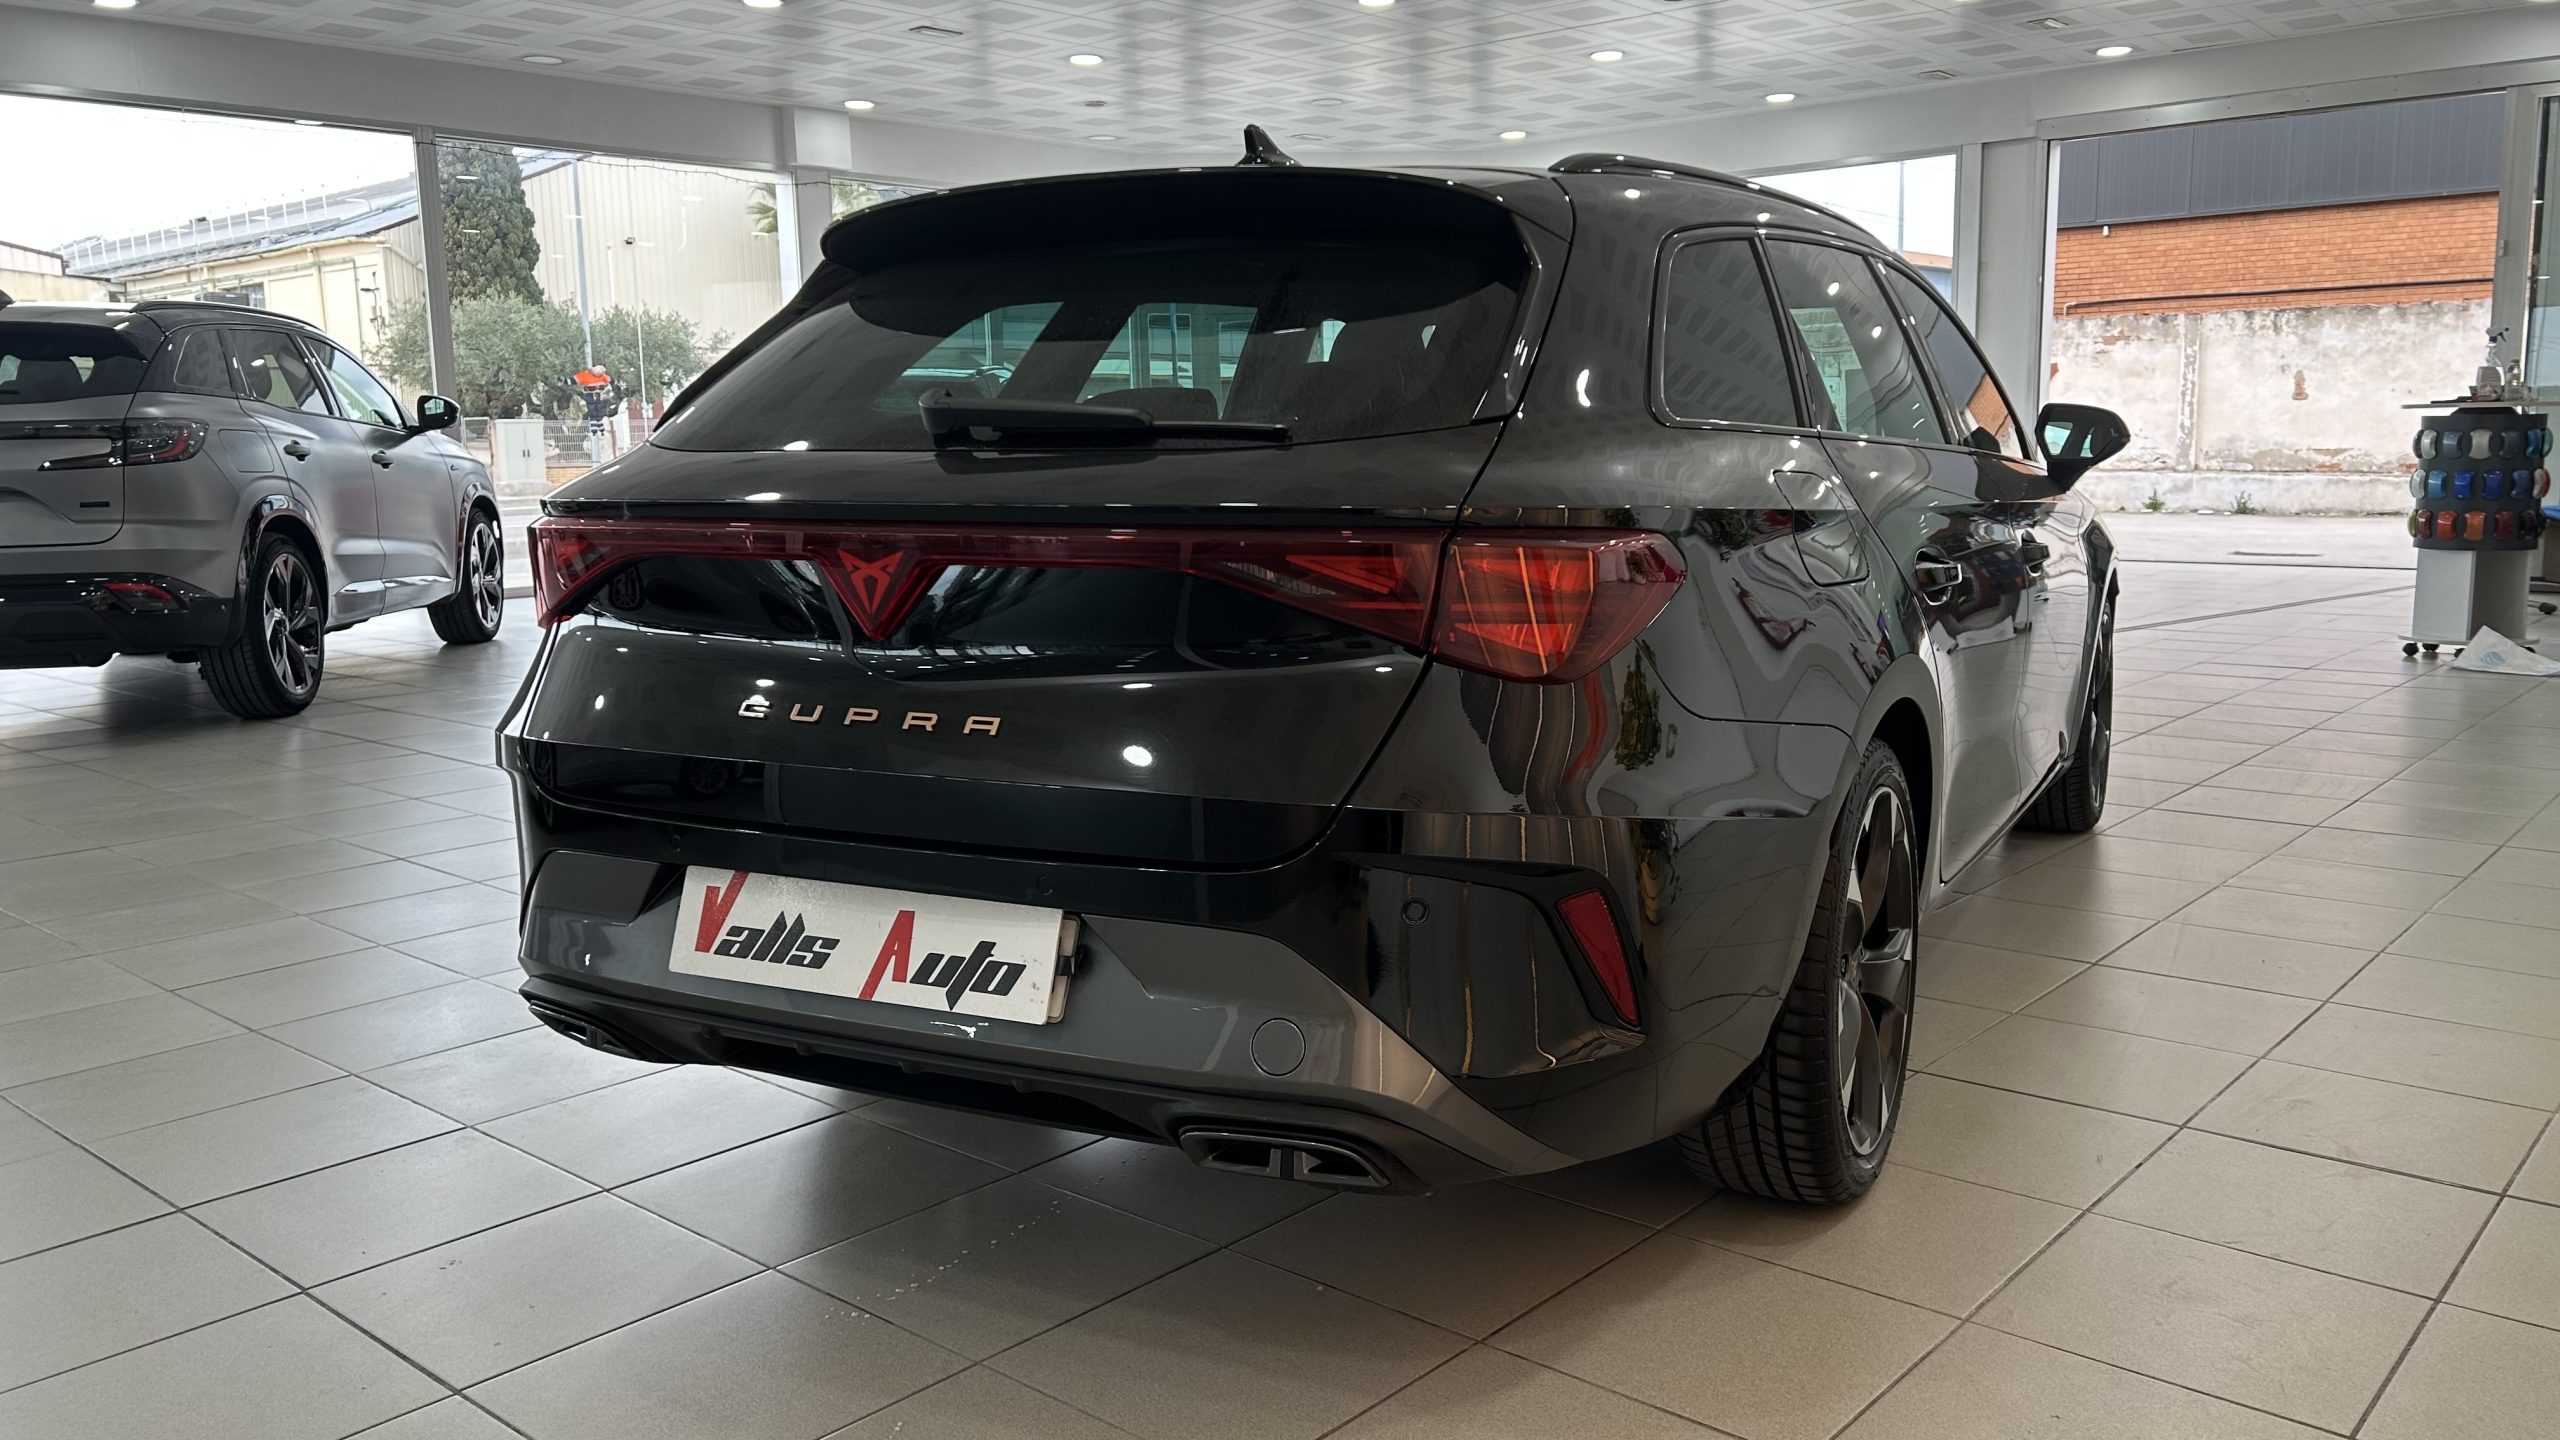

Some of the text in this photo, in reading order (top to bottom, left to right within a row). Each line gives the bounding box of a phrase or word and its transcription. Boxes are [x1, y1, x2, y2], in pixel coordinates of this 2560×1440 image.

[738, 699, 1001, 736] CUPRA
[694, 871, 1027, 1011] Valls Auto
